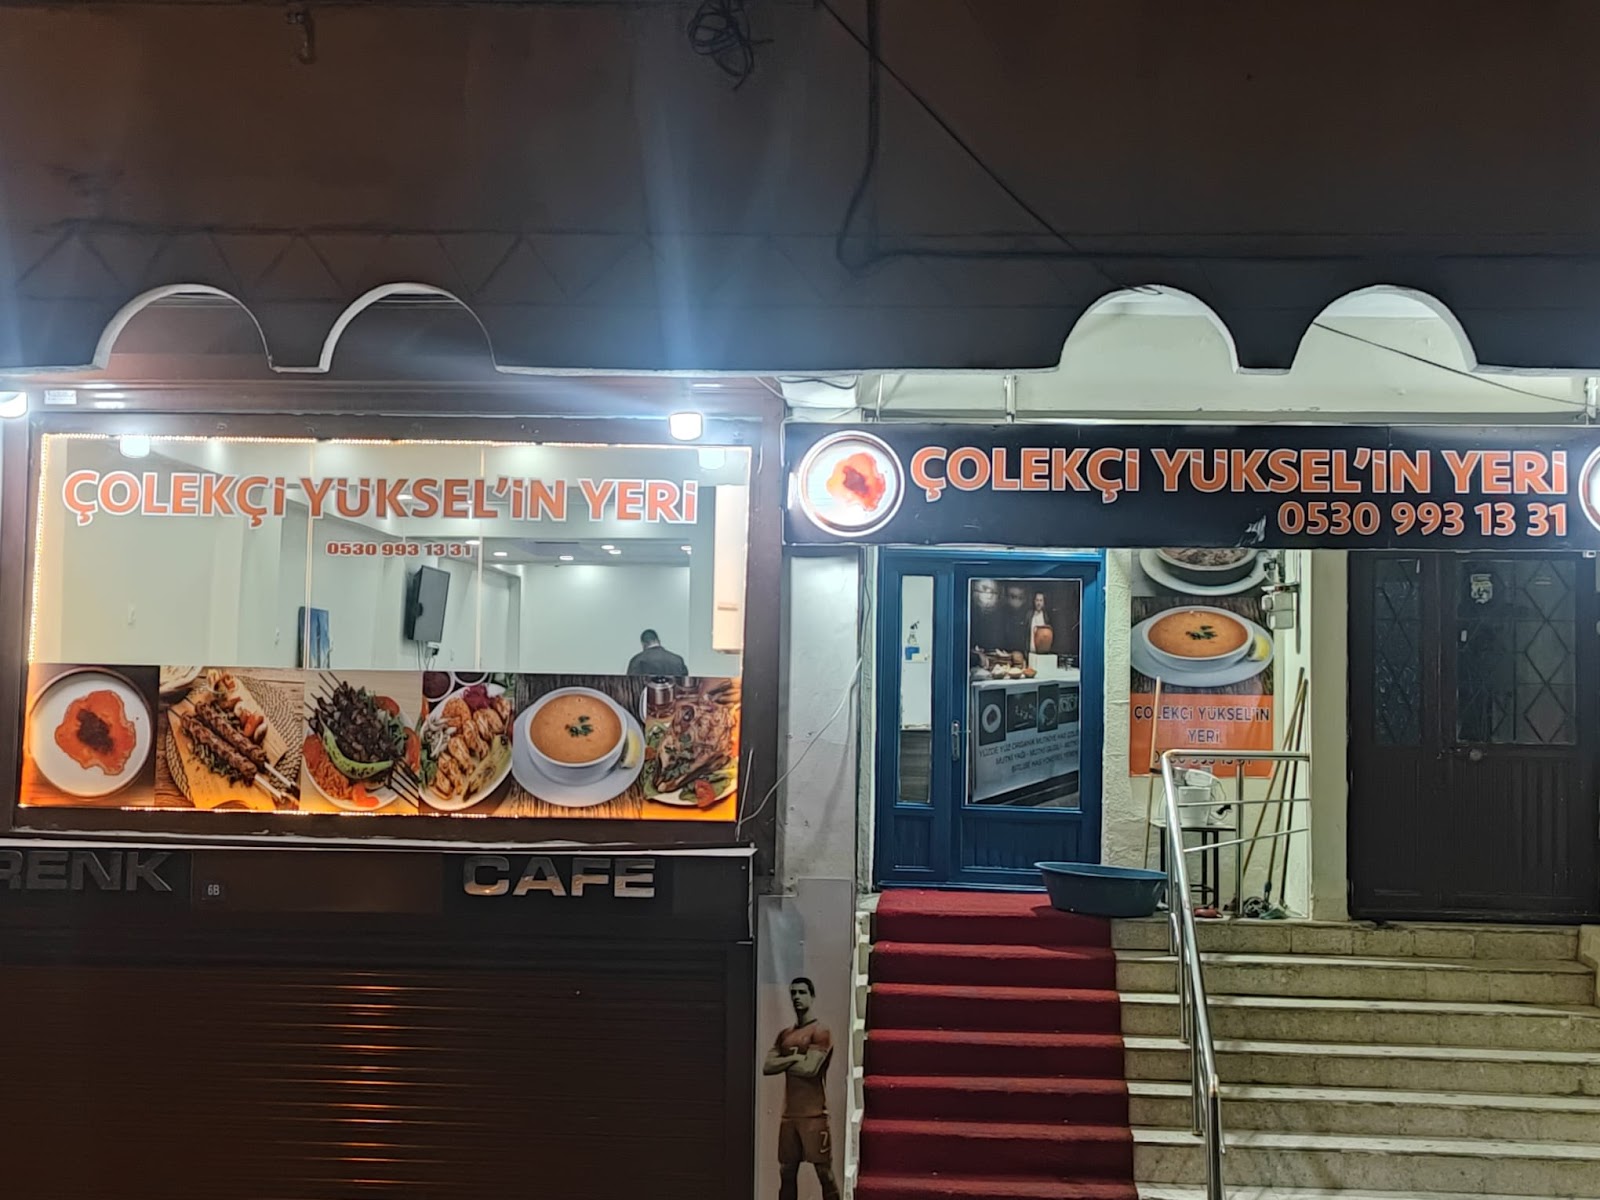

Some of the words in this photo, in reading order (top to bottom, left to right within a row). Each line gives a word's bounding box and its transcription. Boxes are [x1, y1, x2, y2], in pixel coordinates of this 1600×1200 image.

[1440, 450, 1568, 494] YERİ
[578, 478, 699, 524] YERİ
[1277, 501, 1381, 536] 0530
[1390, 502, 1464, 537] 993
[1475, 503, 1516, 536] 13
[1526, 503, 1567, 537] 31
[326, 541, 377, 556] 0530
[381, 542, 420, 557] 993
[423, 542, 446, 556] 13
[449, 543, 473, 556] 31
[463, 855, 656, 898] CAFE
